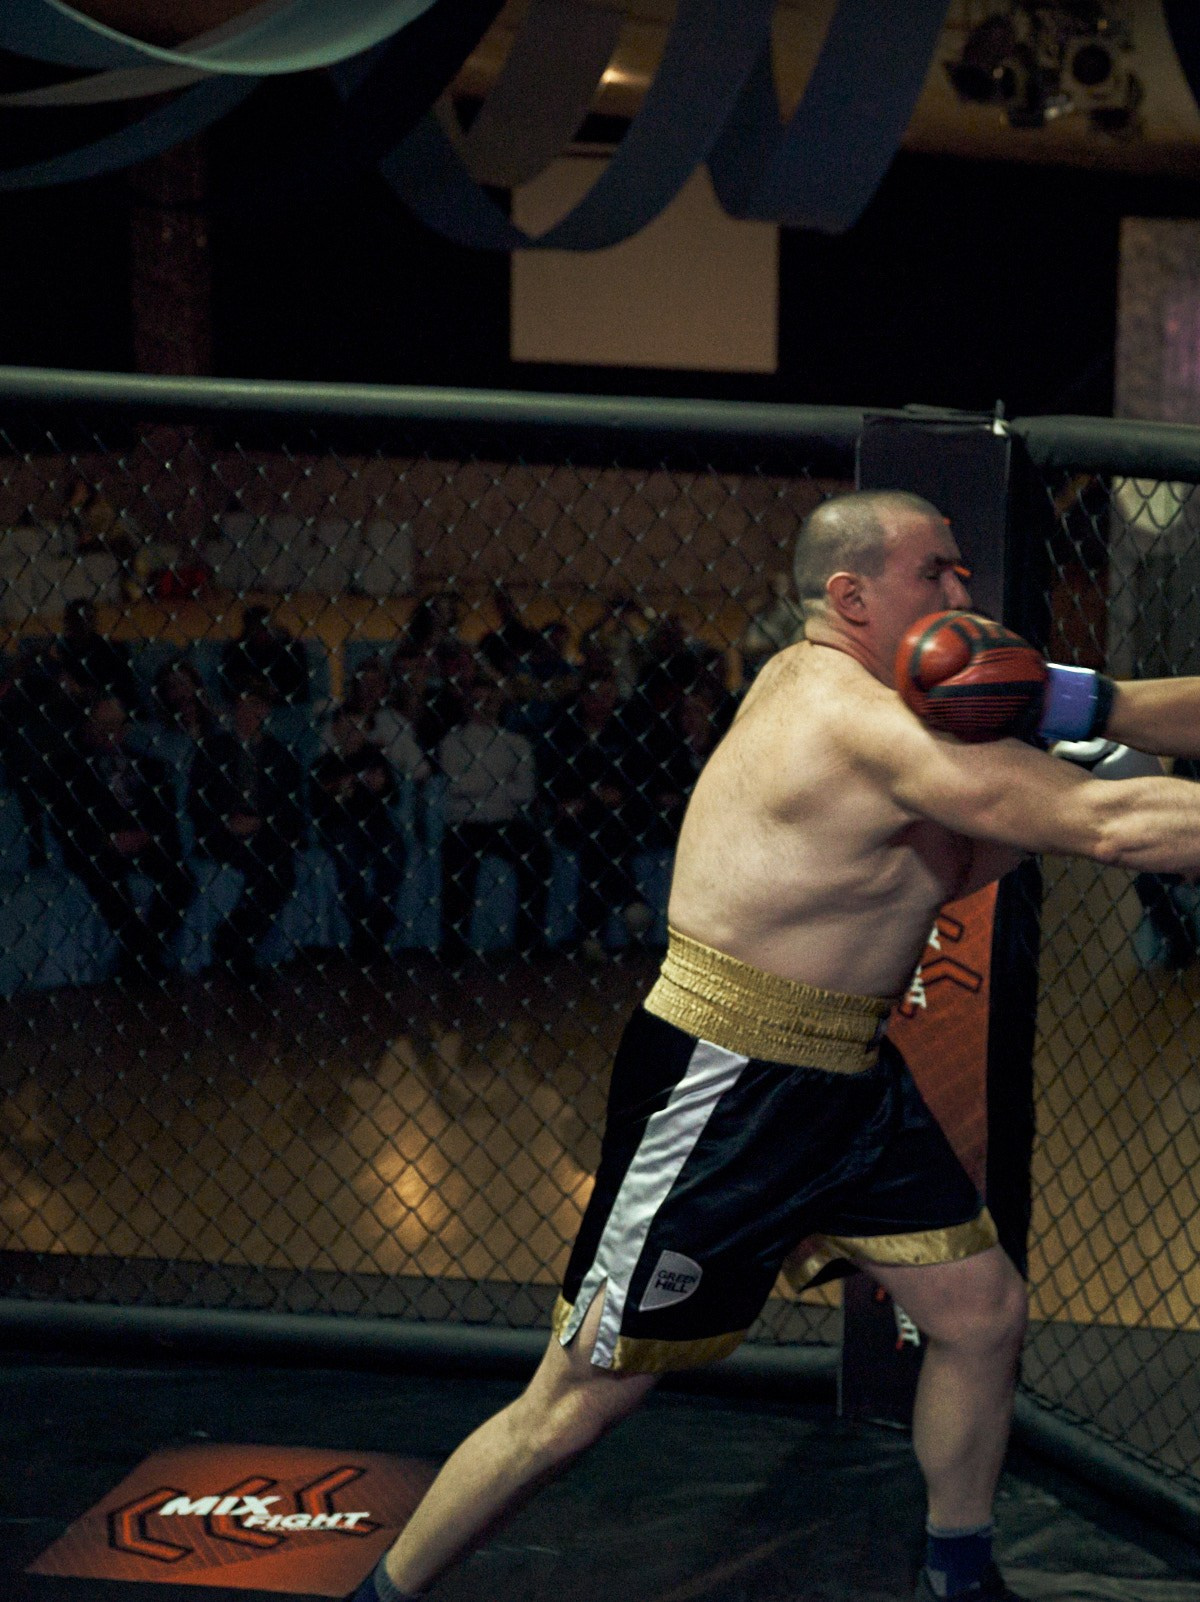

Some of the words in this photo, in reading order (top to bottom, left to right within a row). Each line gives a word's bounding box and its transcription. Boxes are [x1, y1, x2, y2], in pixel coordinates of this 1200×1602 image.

[654, 1279, 688, 1293] HILL
[159, 1495, 282, 1516] MIX
[242, 1511, 370, 1529] FIGHT
